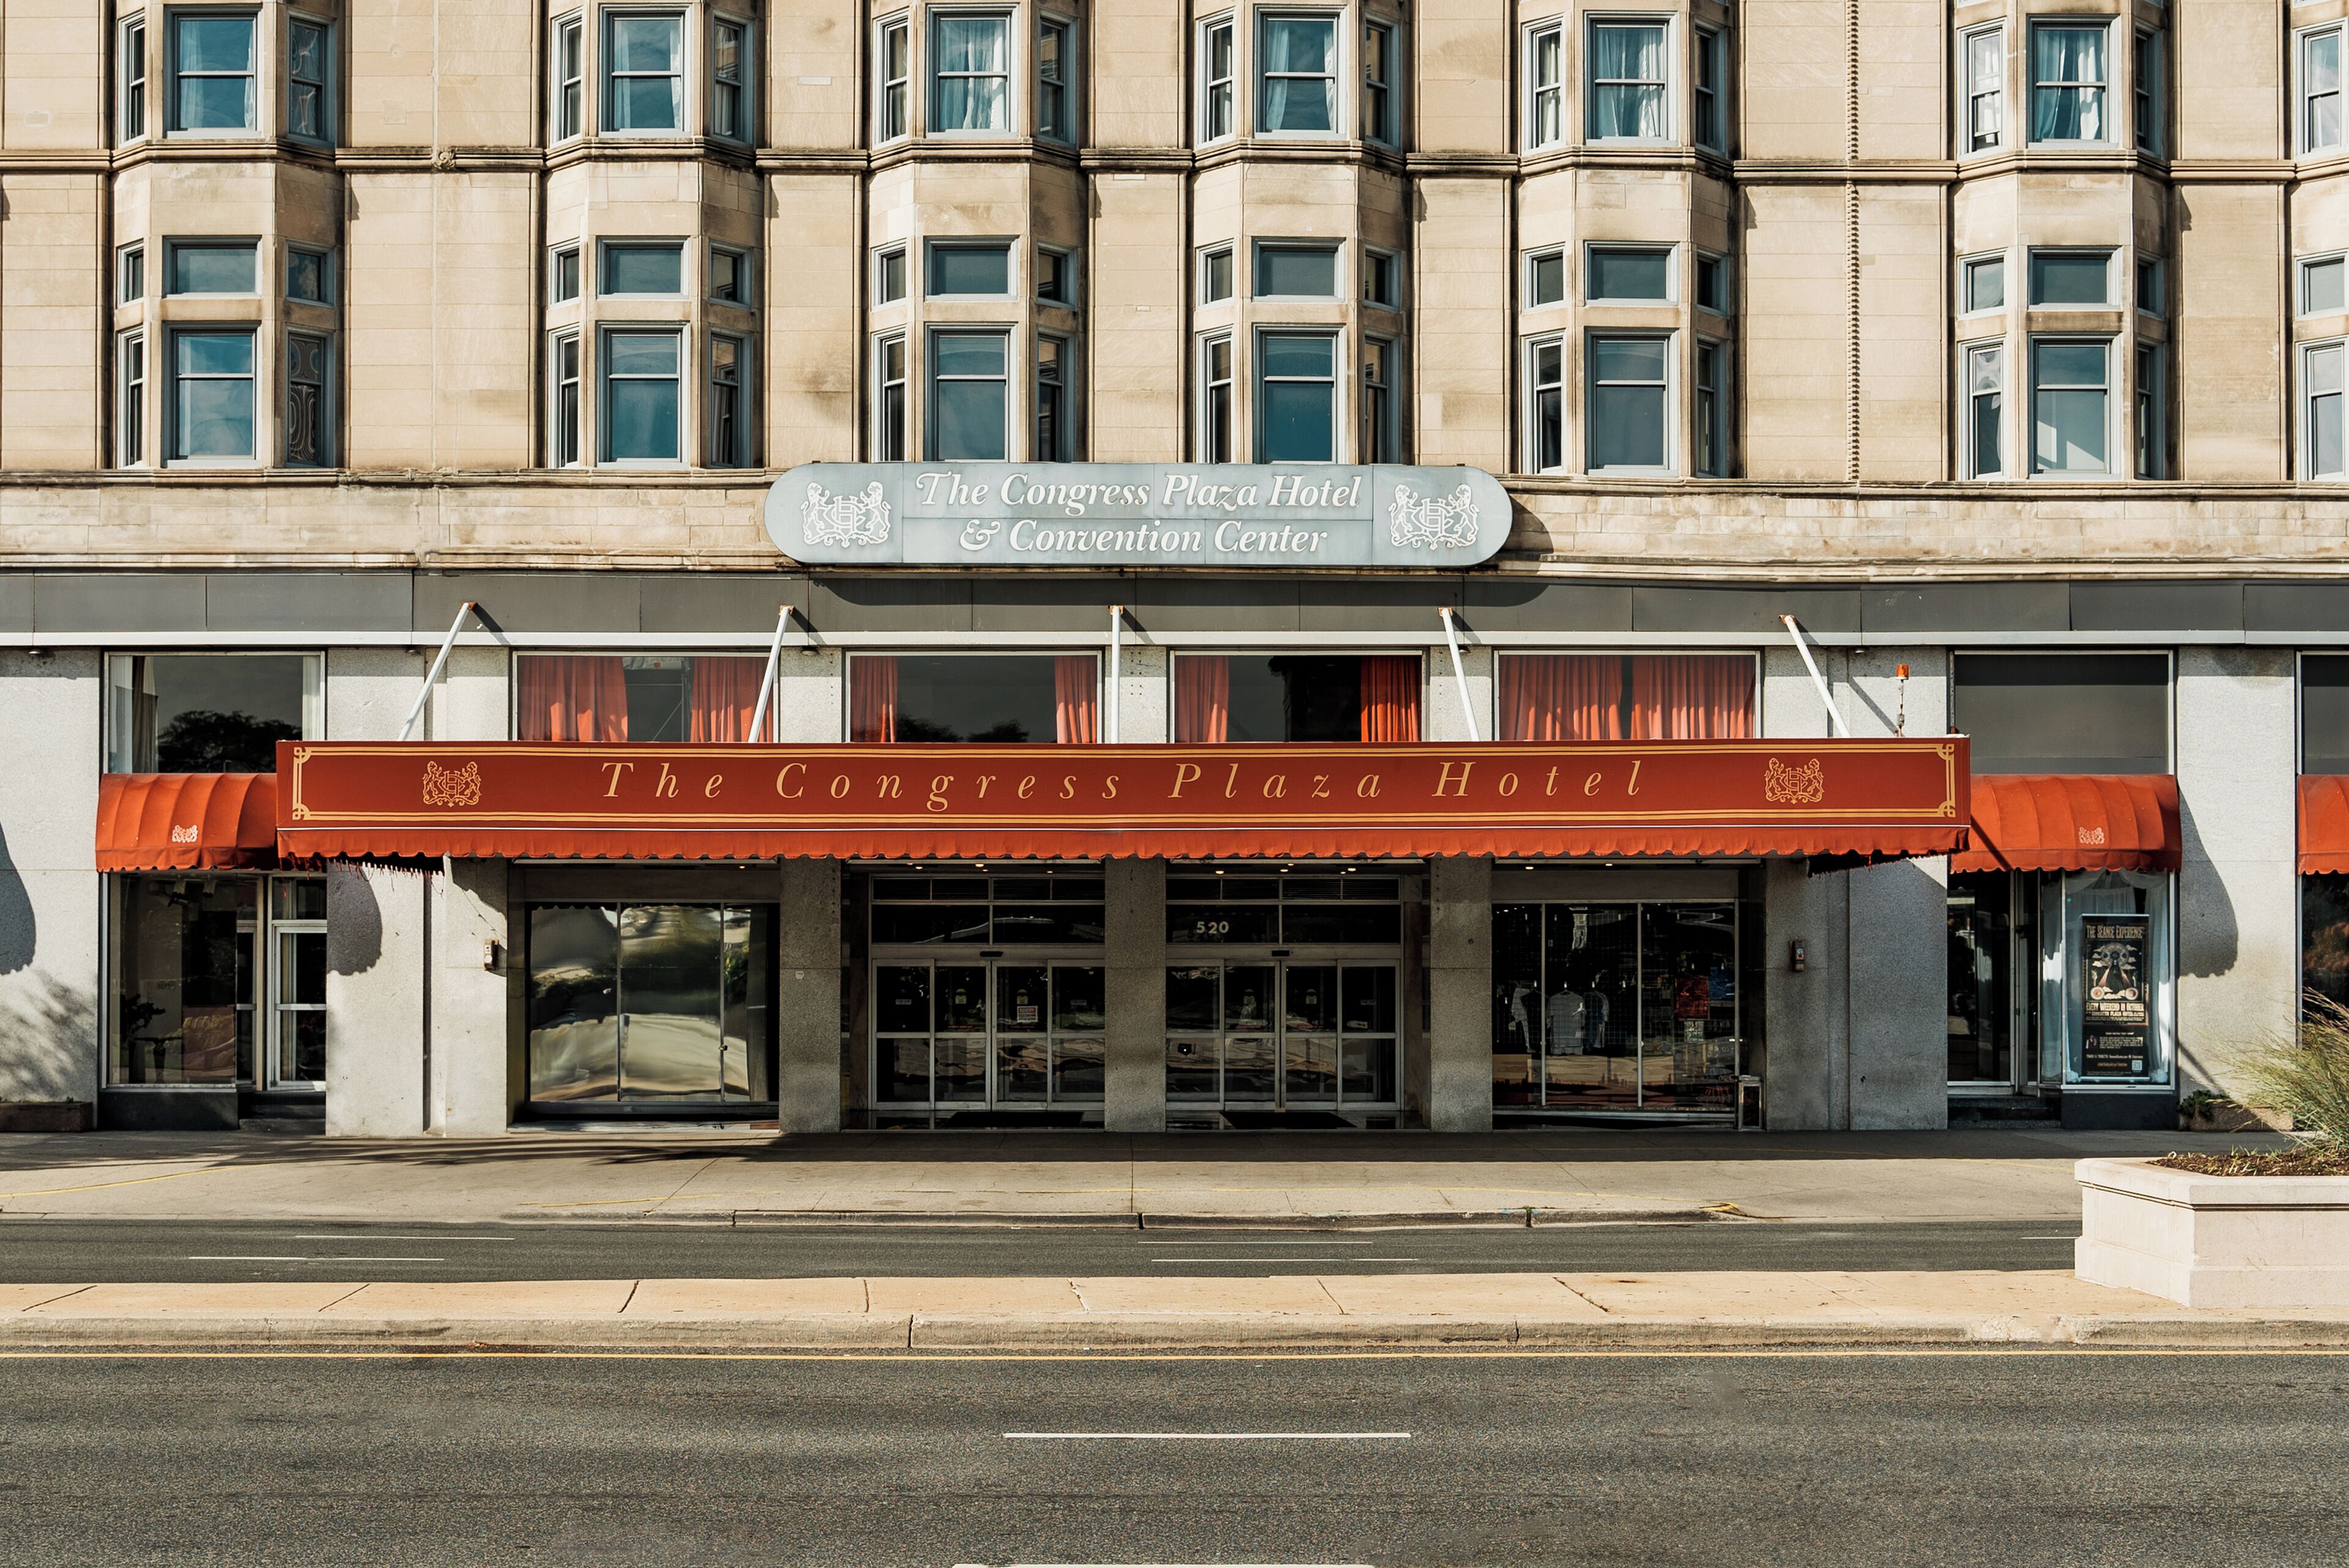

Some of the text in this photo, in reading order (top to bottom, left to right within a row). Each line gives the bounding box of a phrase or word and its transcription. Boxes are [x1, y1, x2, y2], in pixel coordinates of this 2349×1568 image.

[916, 472, 1363, 517] The Congress Plaza Hotel
[959, 519, 1329, 553] & Convention Center
[601, 760, 1641, 813] The Congress Plaza Hotel
[1197, 921, 1229, 934] 520
[2087, 925, 2096, 938] THE
[2116, 925, 2143, 938] EXPERIENCE
